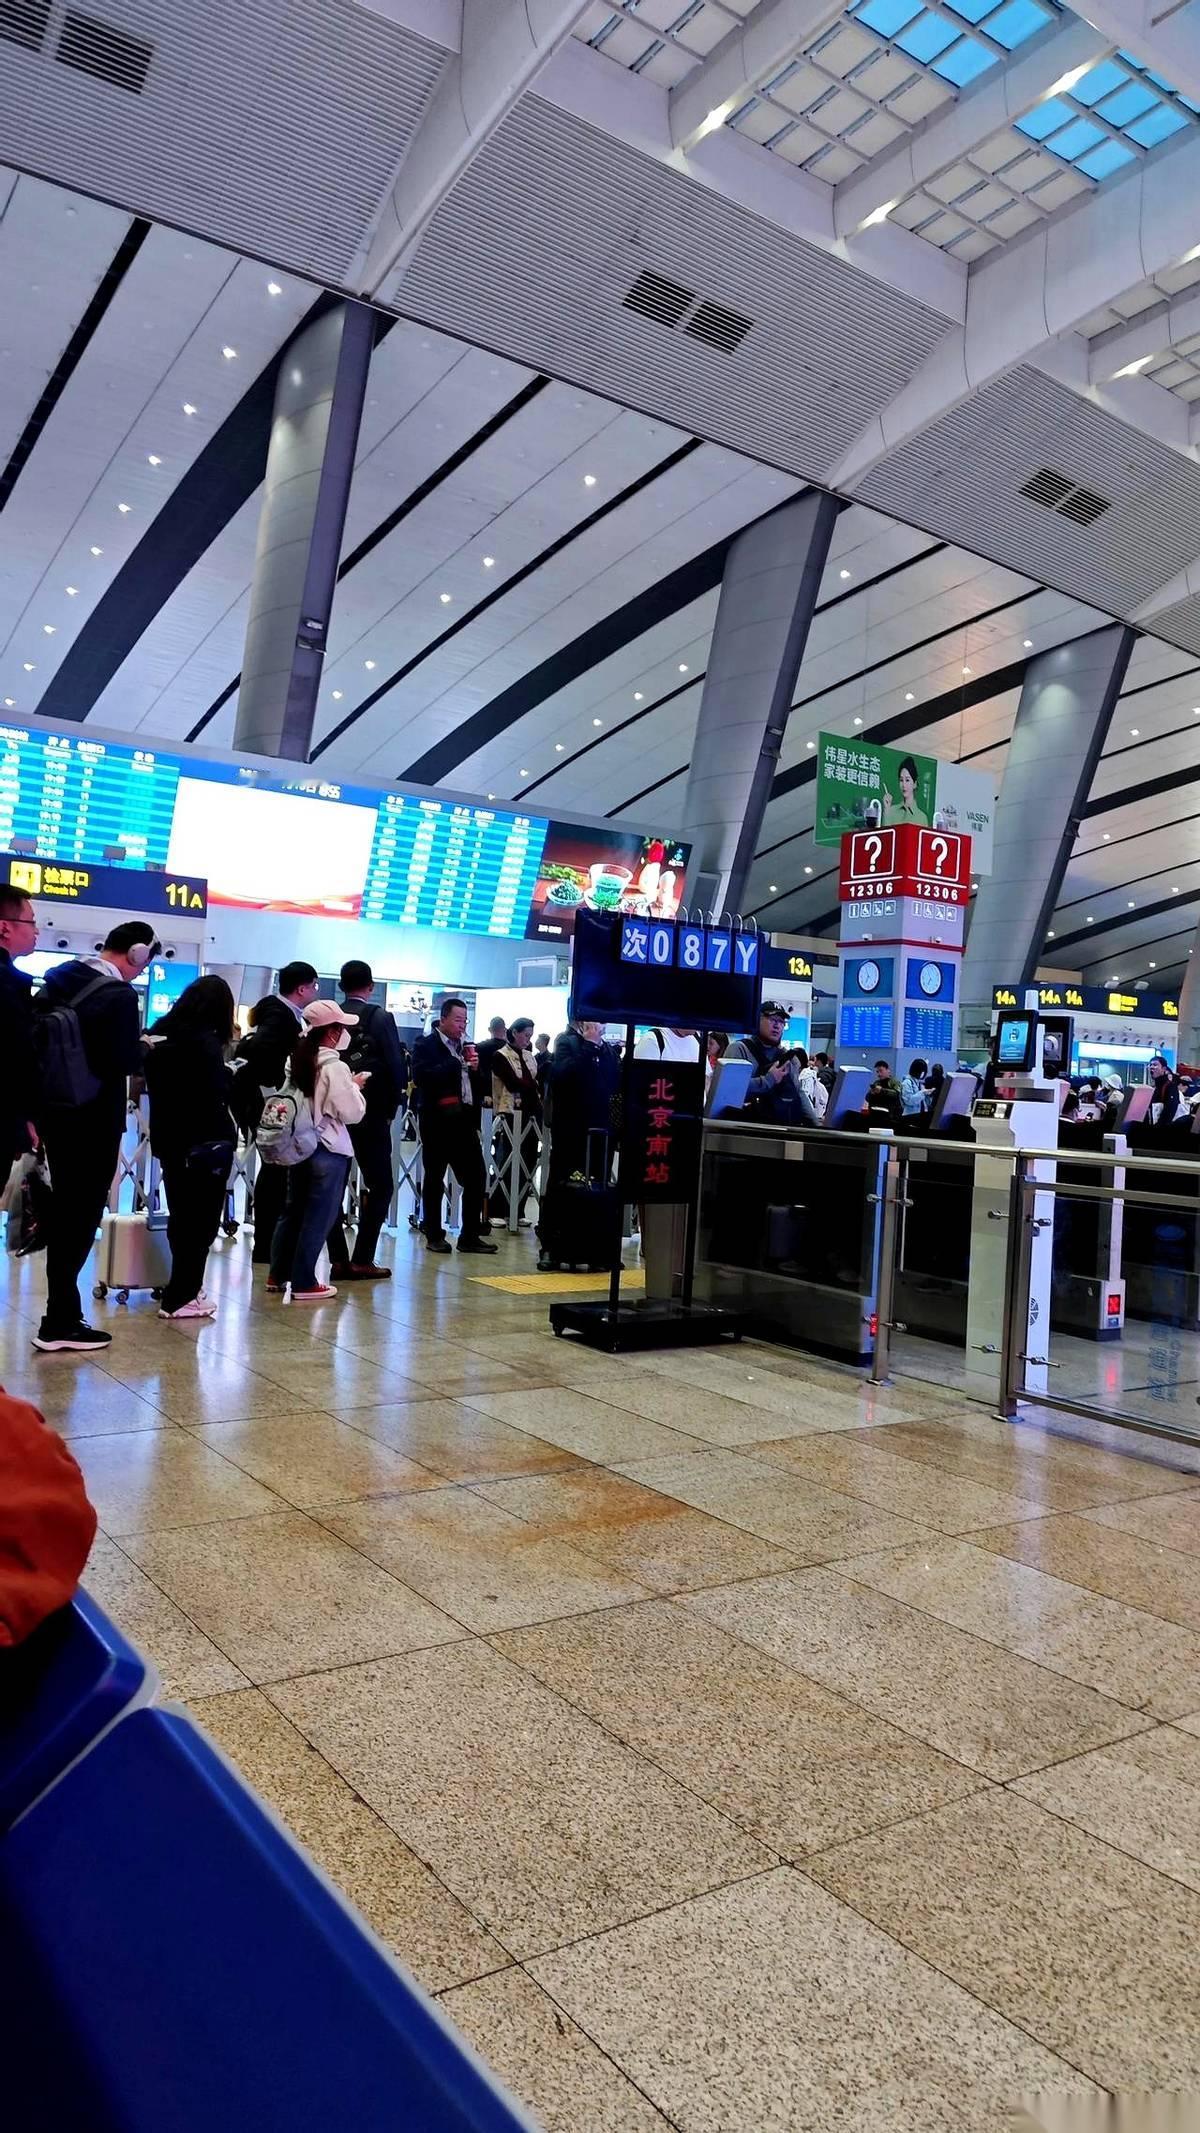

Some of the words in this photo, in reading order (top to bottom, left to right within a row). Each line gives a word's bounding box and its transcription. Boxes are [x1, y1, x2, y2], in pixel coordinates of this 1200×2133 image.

[824, 745, 881, 772] 伟星水生态
[823, 763, 880, 790] 家装更信赖
[966, 811, 989, 824] VASEN
[165, 882, 203, 909] 11A
[849, 882, 894, 898] 12306
[916, 883, 958, 901] 12306
[788, 957, 811, 976] 13A
[995, 990, 1016, 1006] 14A
[1039, 989, 1061, 1005] 14A
[1065, 990, 1083, 1006] 14A
[643, 1078, 675, 1184] 北京南站
